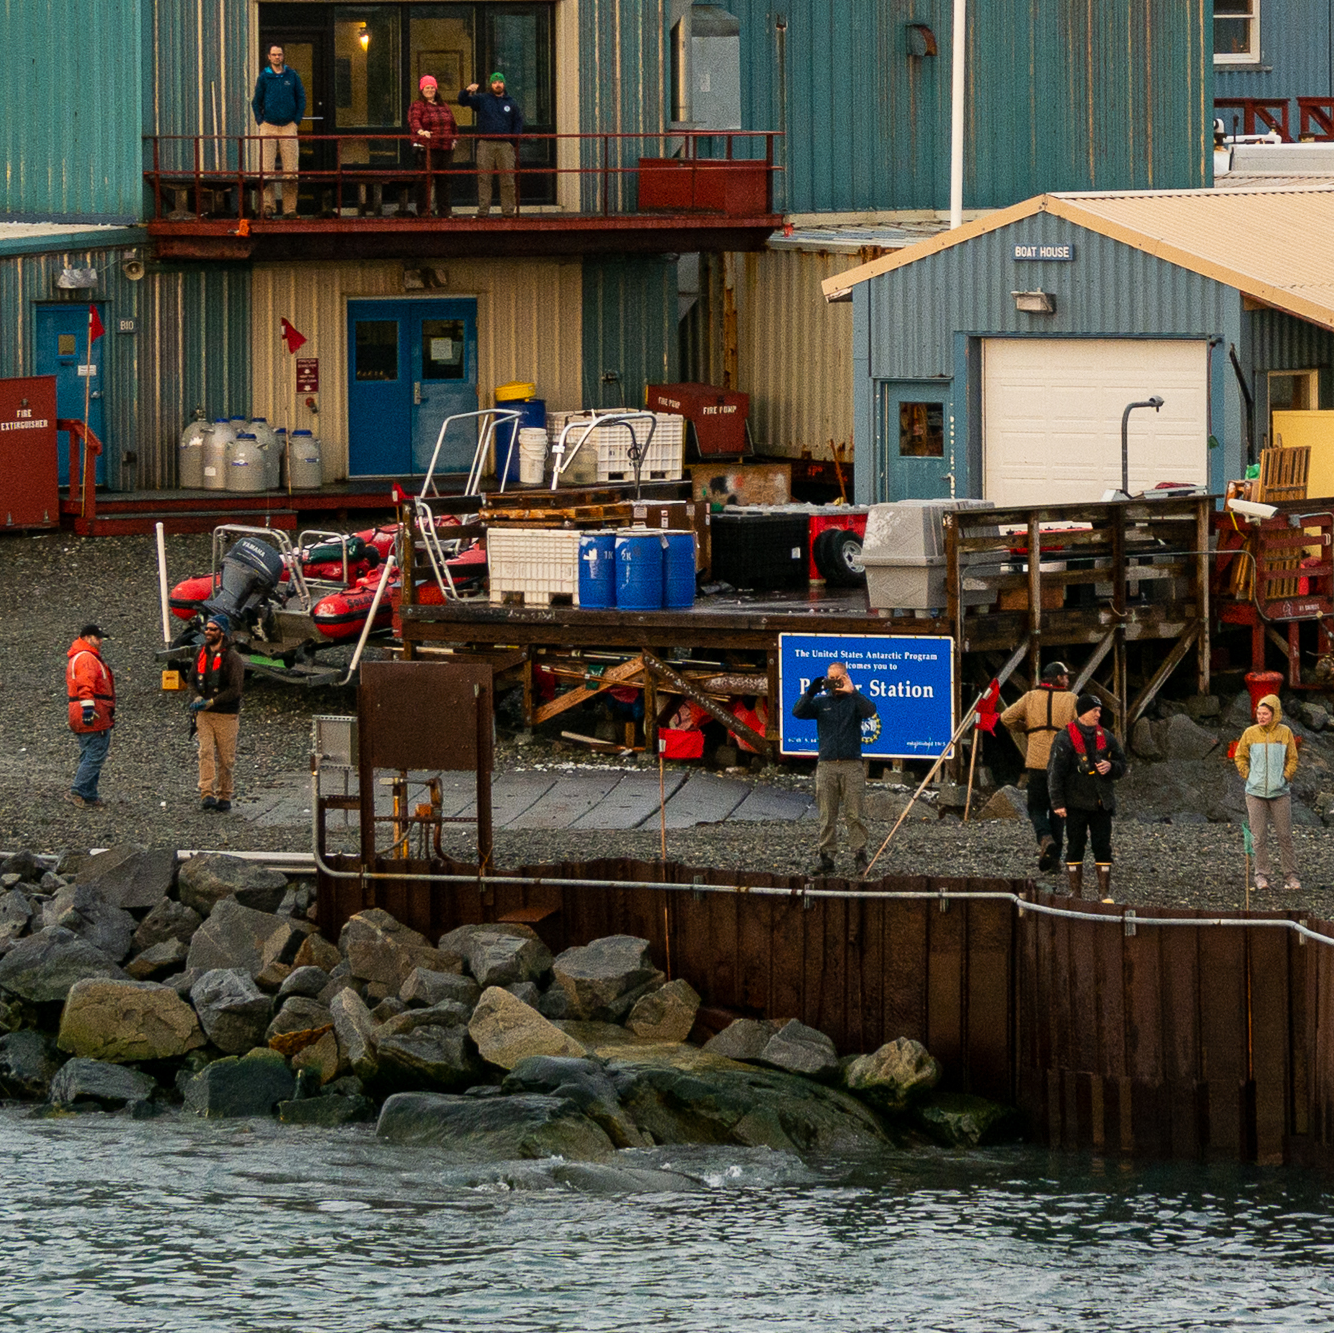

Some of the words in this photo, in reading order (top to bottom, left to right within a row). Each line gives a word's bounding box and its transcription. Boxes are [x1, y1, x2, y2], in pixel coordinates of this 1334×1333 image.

[1015, 246, 1037, 257] BOAT
[1040, 246, 1069, 258] HOUSE
[16, 409, 32, 418] FIRE
[702, 406, 717, 415] FIRE
[0, 419, 48, 431] EXTINGUISHER
[795, 649, 810, 658] The
[812, 650, 838, 658] United
[840, 650, 863, 659] States
[866, 651, 902, 660] Antarctic
[904, 652, 937, 662] Program
[873, 663, 887, 672] you
[869, 679, 934, 698] Station
